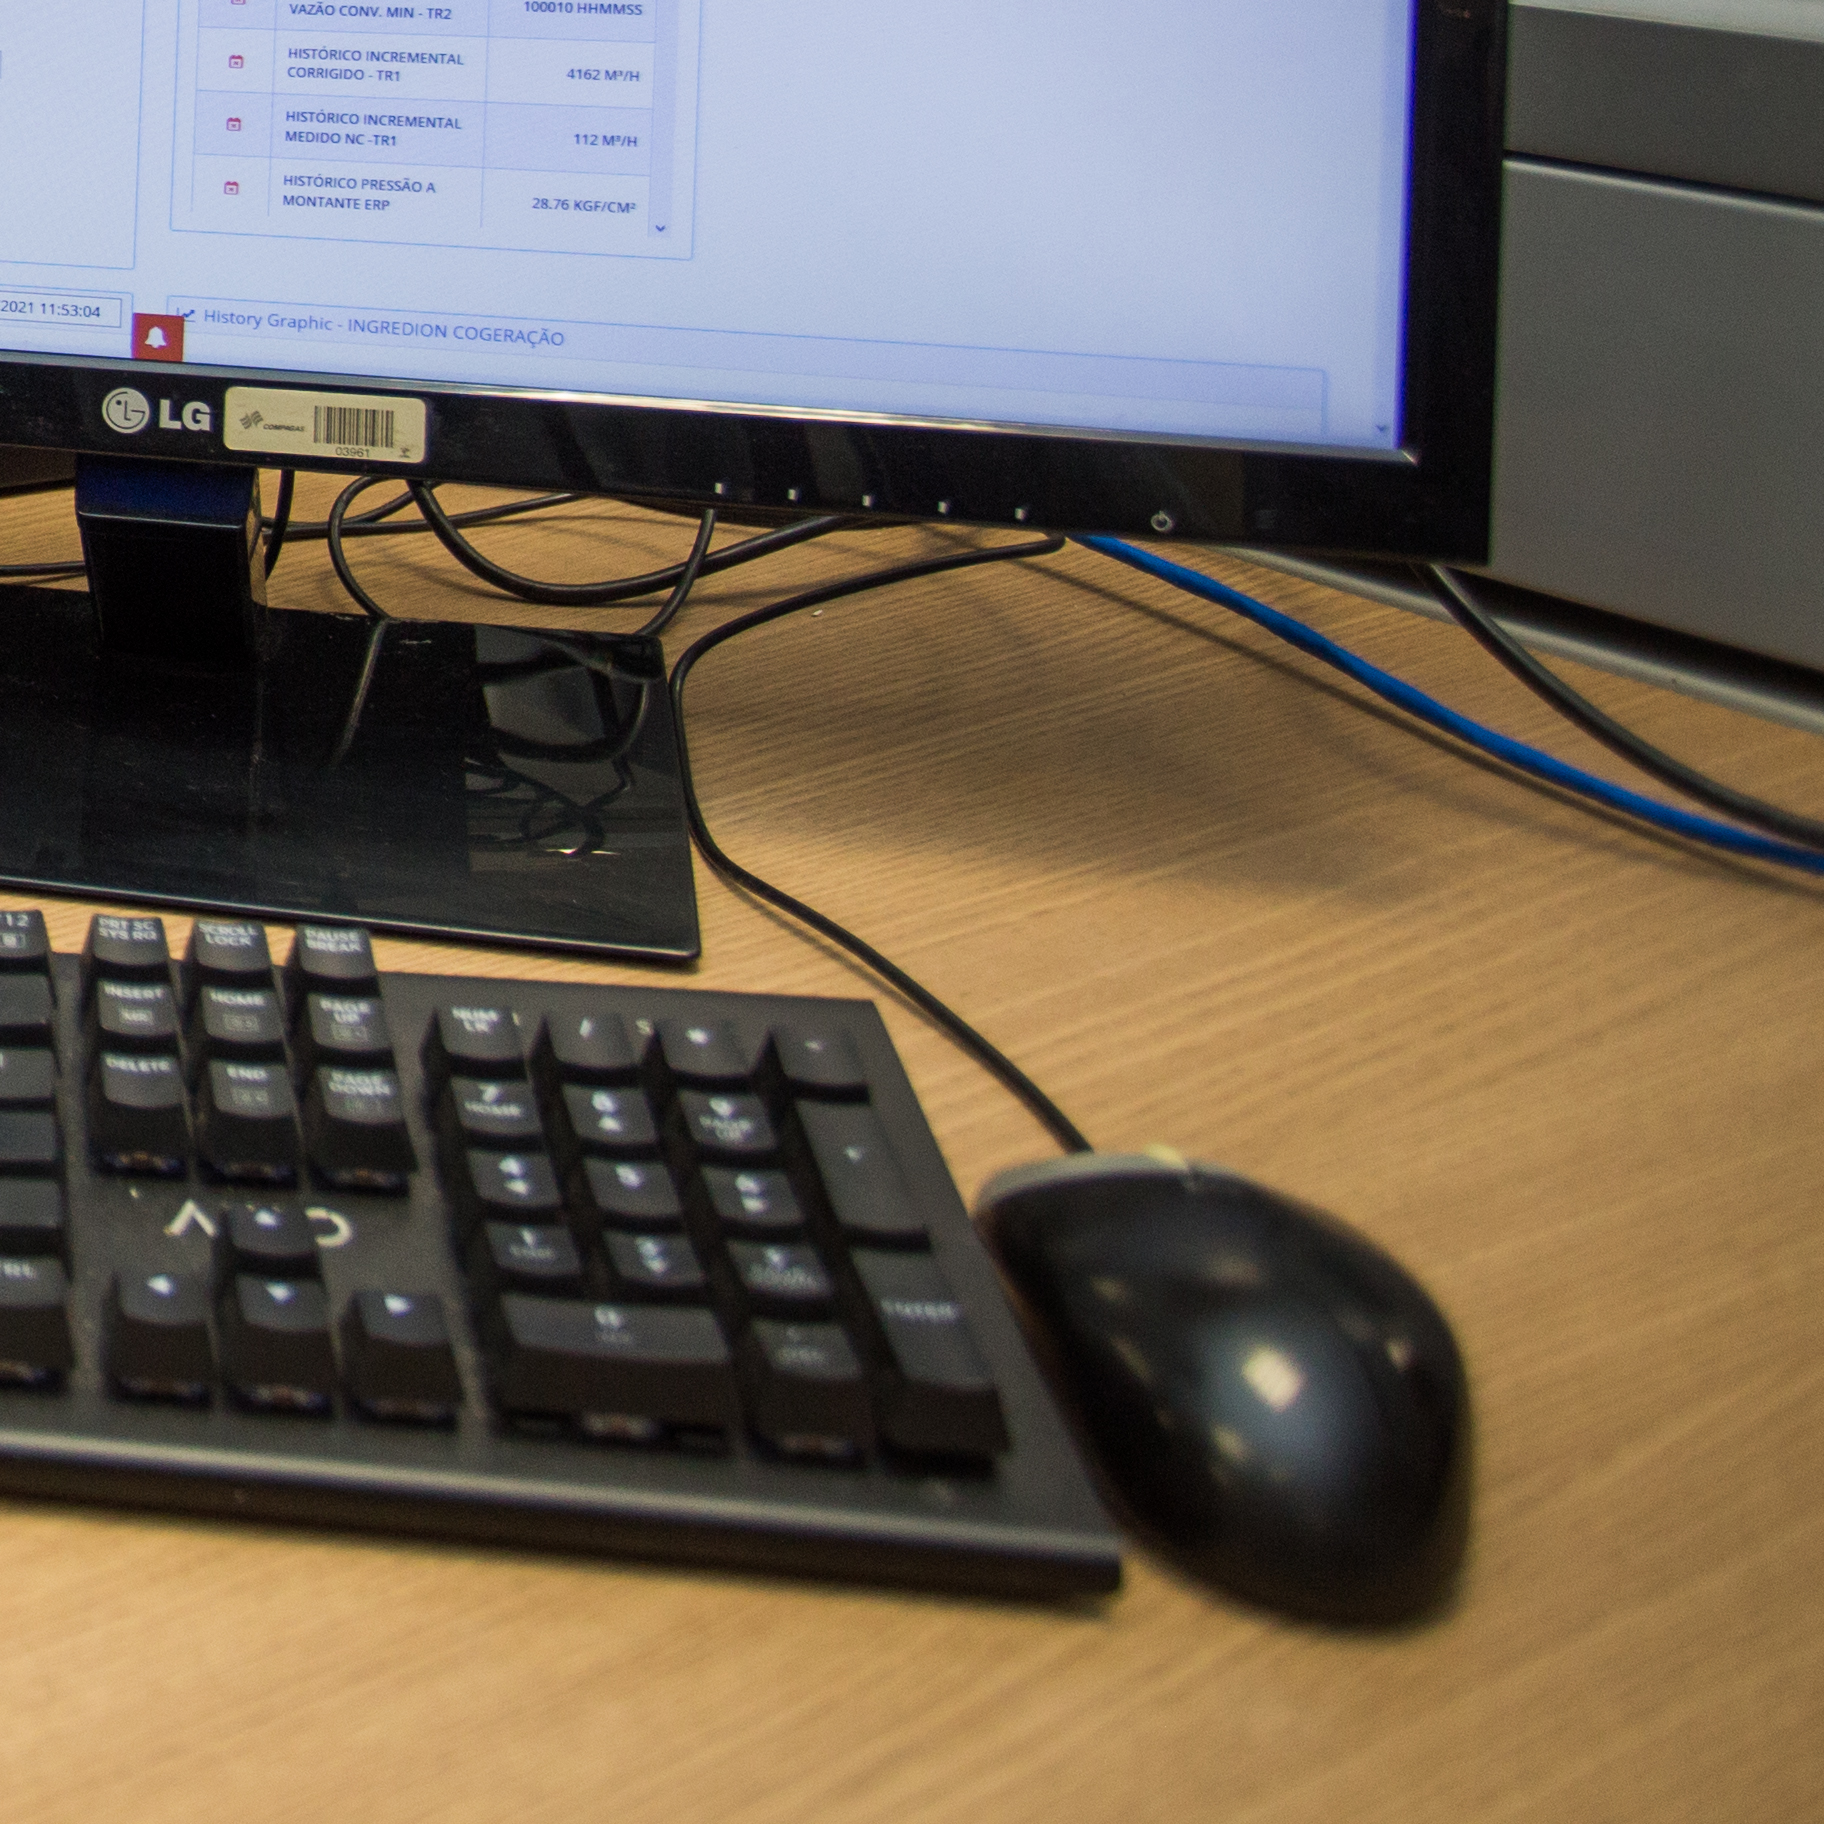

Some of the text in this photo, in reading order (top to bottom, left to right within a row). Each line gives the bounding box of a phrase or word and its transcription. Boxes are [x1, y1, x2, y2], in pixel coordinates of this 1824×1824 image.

[283, 173, 422, 193] HISTÓRICO PRESSÃO
[283, 195, 389, 211] MONTANTE ERP
[533, 197, 636, 214] 28.76 KGF/CM²
[40, 301, 101, 319] 11:53:04
[203, 308, 564, 349] History Graphic INGREDION COGERAÇÃO
[159, 399, 212, 432] LG
[335, 446, 371, 459] 03961
